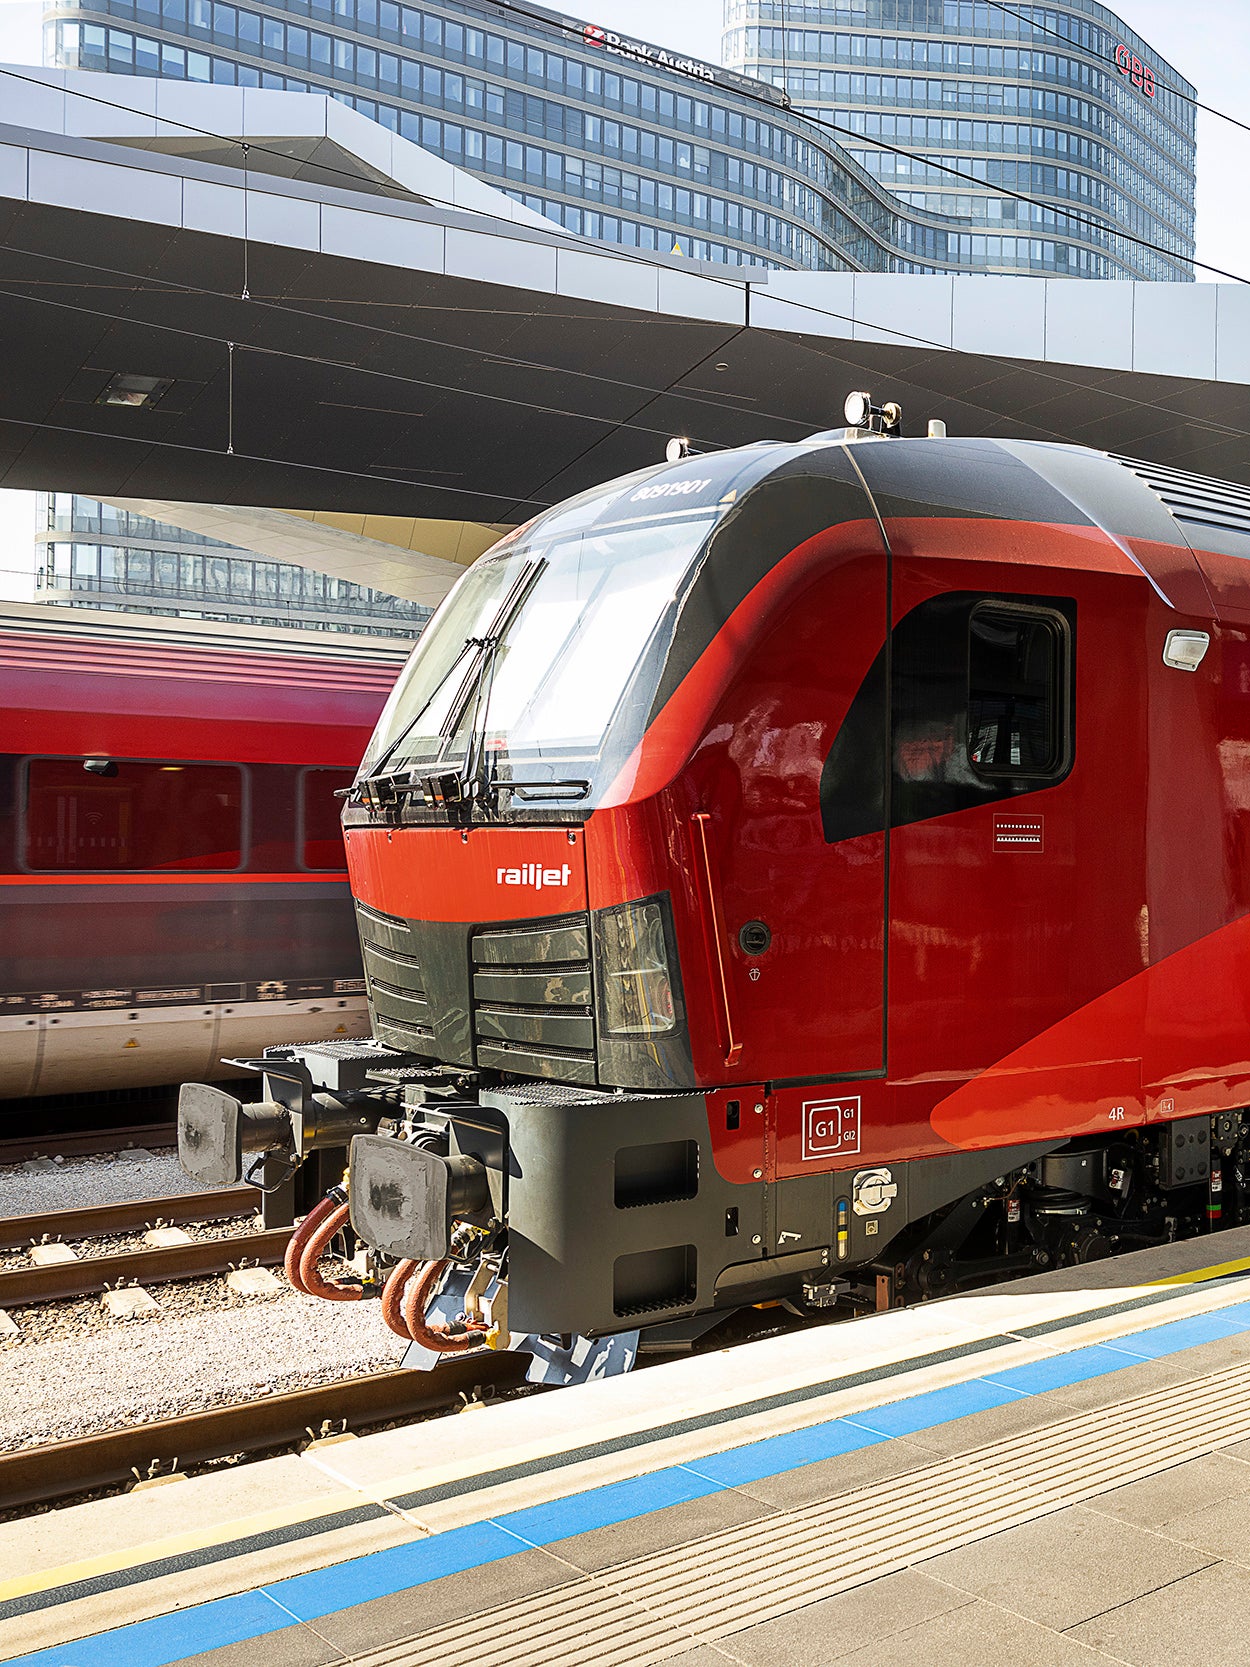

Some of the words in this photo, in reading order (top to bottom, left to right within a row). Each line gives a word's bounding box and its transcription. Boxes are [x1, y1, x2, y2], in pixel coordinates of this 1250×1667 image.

[606, 32, 656, 67] Bank
[657, 50, 715, 85] Austria
[630, 479, 712, 501] 8091901
[496, 863, 572, 890] railjet
[843, 1108, 854, 1119] G1
[1108, 1106, 1125, 1121] 4R
[815, 1120, 834, 1137] G1
